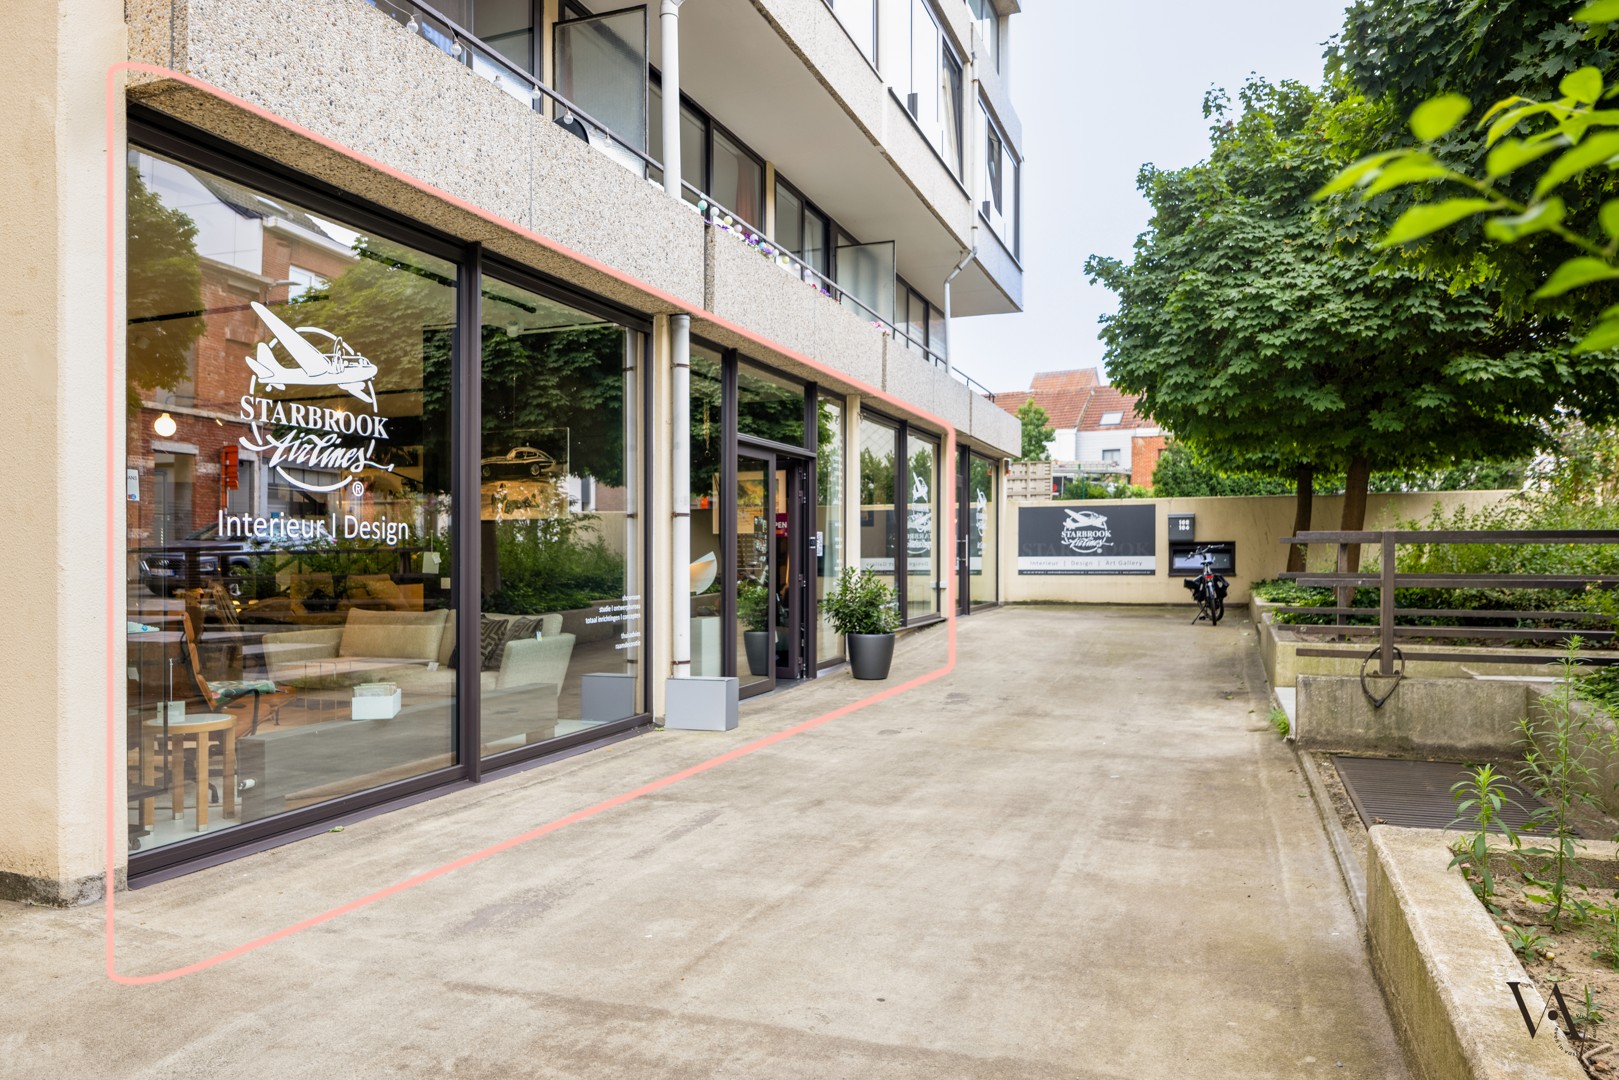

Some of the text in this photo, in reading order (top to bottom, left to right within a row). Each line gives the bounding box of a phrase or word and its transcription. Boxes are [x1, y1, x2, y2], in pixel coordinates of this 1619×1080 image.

[240, 395, 389, 440] STARBROOK
[218, 509, 409, 545] Interieur Design
[1061, 529, 1112, 538] STARBROOK
